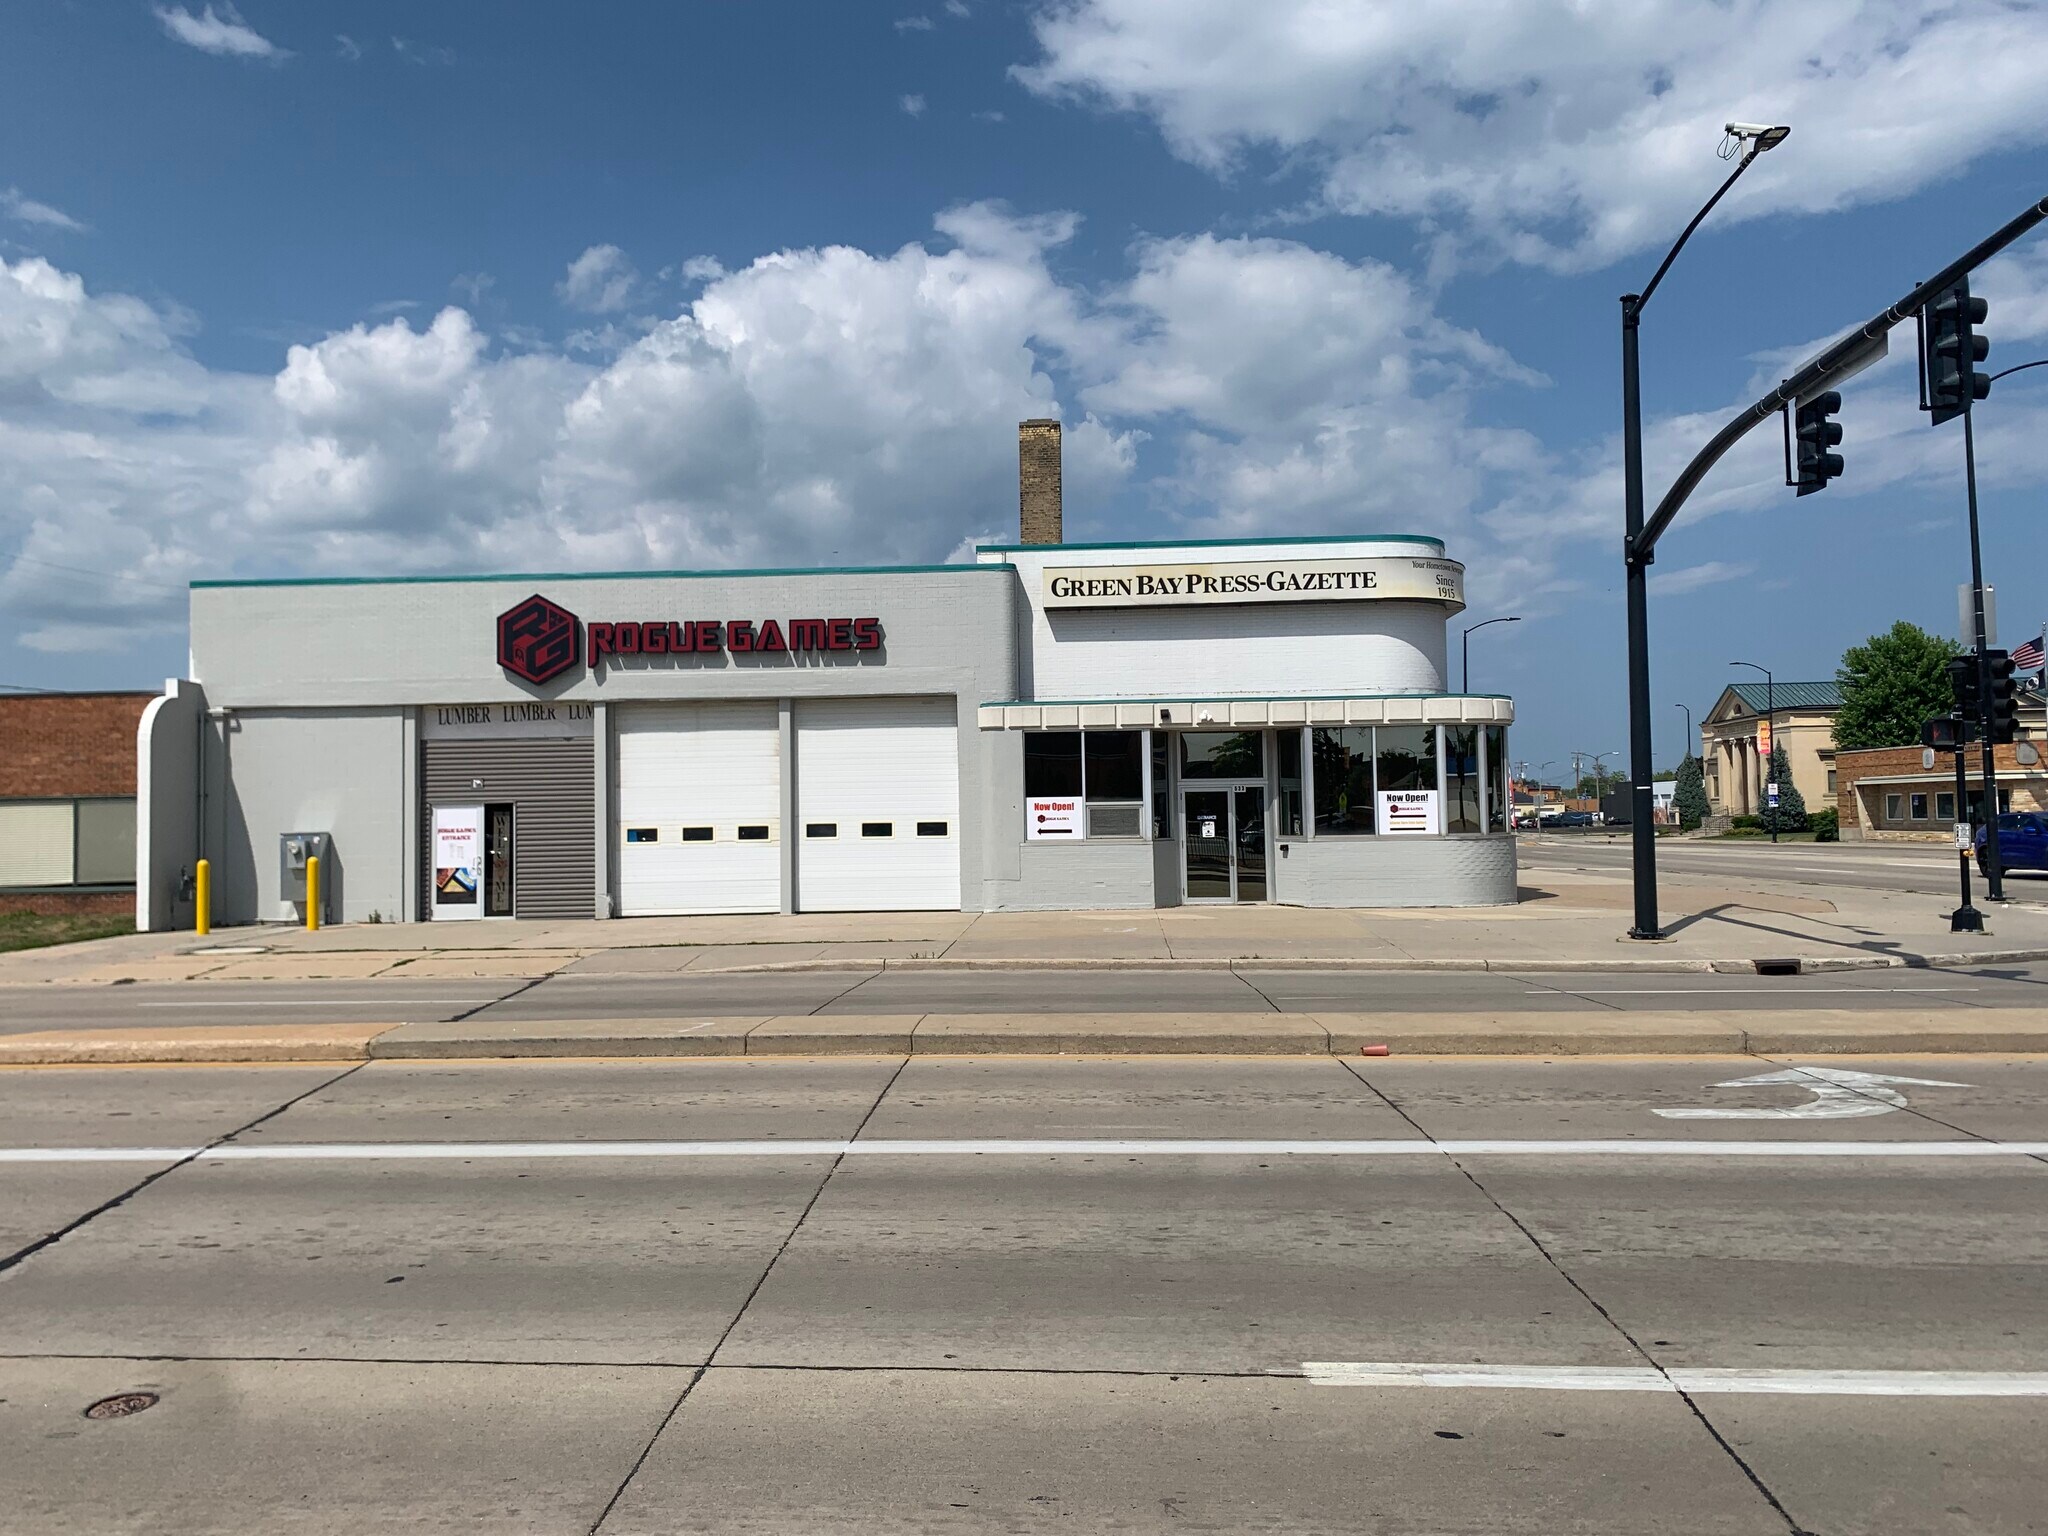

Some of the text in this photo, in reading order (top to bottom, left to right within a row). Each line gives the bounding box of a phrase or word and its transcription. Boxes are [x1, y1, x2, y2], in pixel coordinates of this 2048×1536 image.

[1412, 560, 1425, 569] Your
[1051, 570, 1377, 598] GREEN BAY PRESS-GAZETTE
[1435, 573, 1455, 587] Since
[1437, 586, 1456, 599] 1915
[587, 617, 880, 669] ROGUE GAMES
[438, 706, 491, 726] LUMBER
[503, 703, 557, 723] LUMBER
[1386, 793, 1428, 802] Now Open!
[1034, 802, 1075, 812] Now Open!
